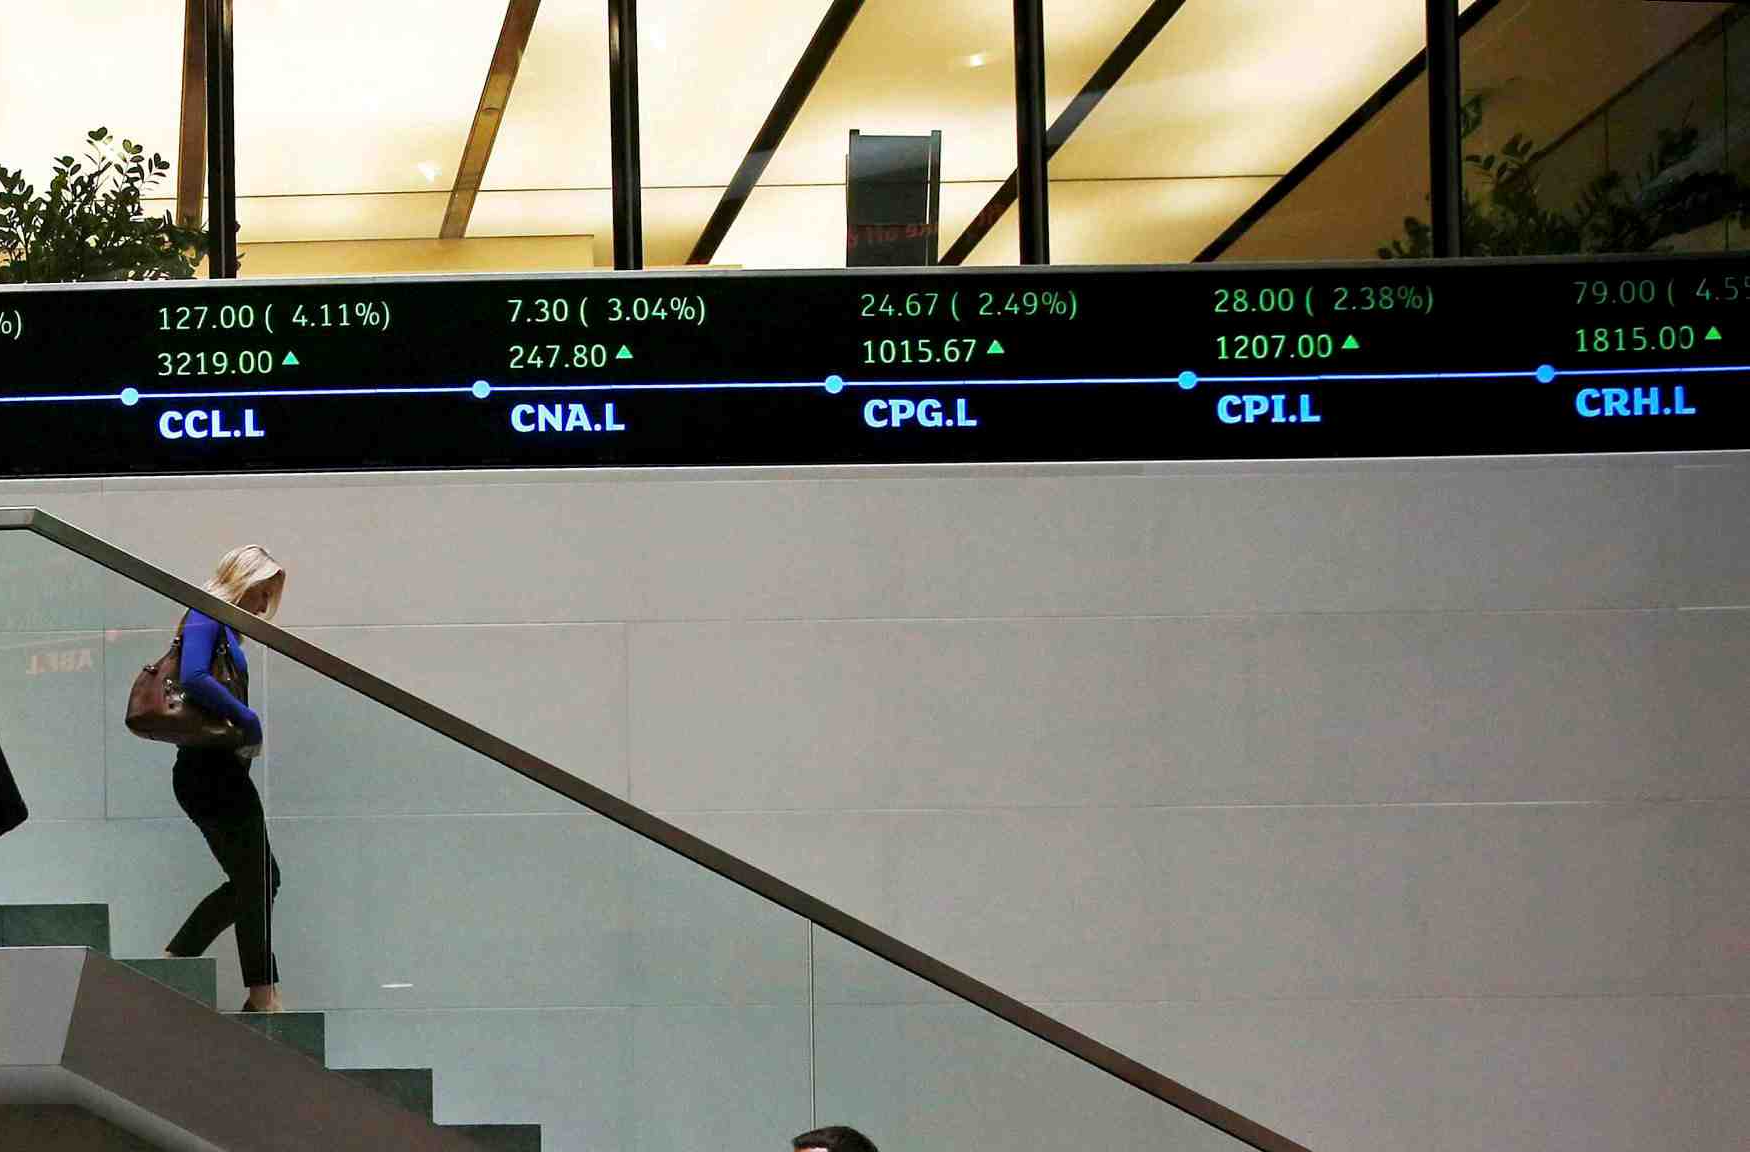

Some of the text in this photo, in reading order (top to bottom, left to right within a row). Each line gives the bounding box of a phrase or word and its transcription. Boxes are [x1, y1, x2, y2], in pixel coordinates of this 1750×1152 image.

[861, 293, 938, 316] 24.67
[979, 291, 1077, 320] 2.49%)
[1214, 288, 1294, 312] 28.00
[1334, 287, 1433, 313] 2.38%)
[1575, 280, 1655, 304] 79.00
[159, 305, 254, 330] 127.00
[292, 301, 389, 330] 4.11%)
[508, 299, 568, 322] 7.30
[608, 296, 705, 325] 3.04%)
[863, 339, 976, 363] 1015.67
[1217, 334, 1333, 359] 1207.00
[1577, 326, 1694, 352] 1815.00
[158, 350, 272, 376] 3219.00
[510, 344, 606, 368] 247.80
[864, 399, 977, 427] CPG.L
[1218, 394, 1320, 423] CPI.L
[1576, 386, 1695, 417] CRH.L
[159, 409, 265, 439] CCL.L
[511, 403, 625, 432] CNA.L
